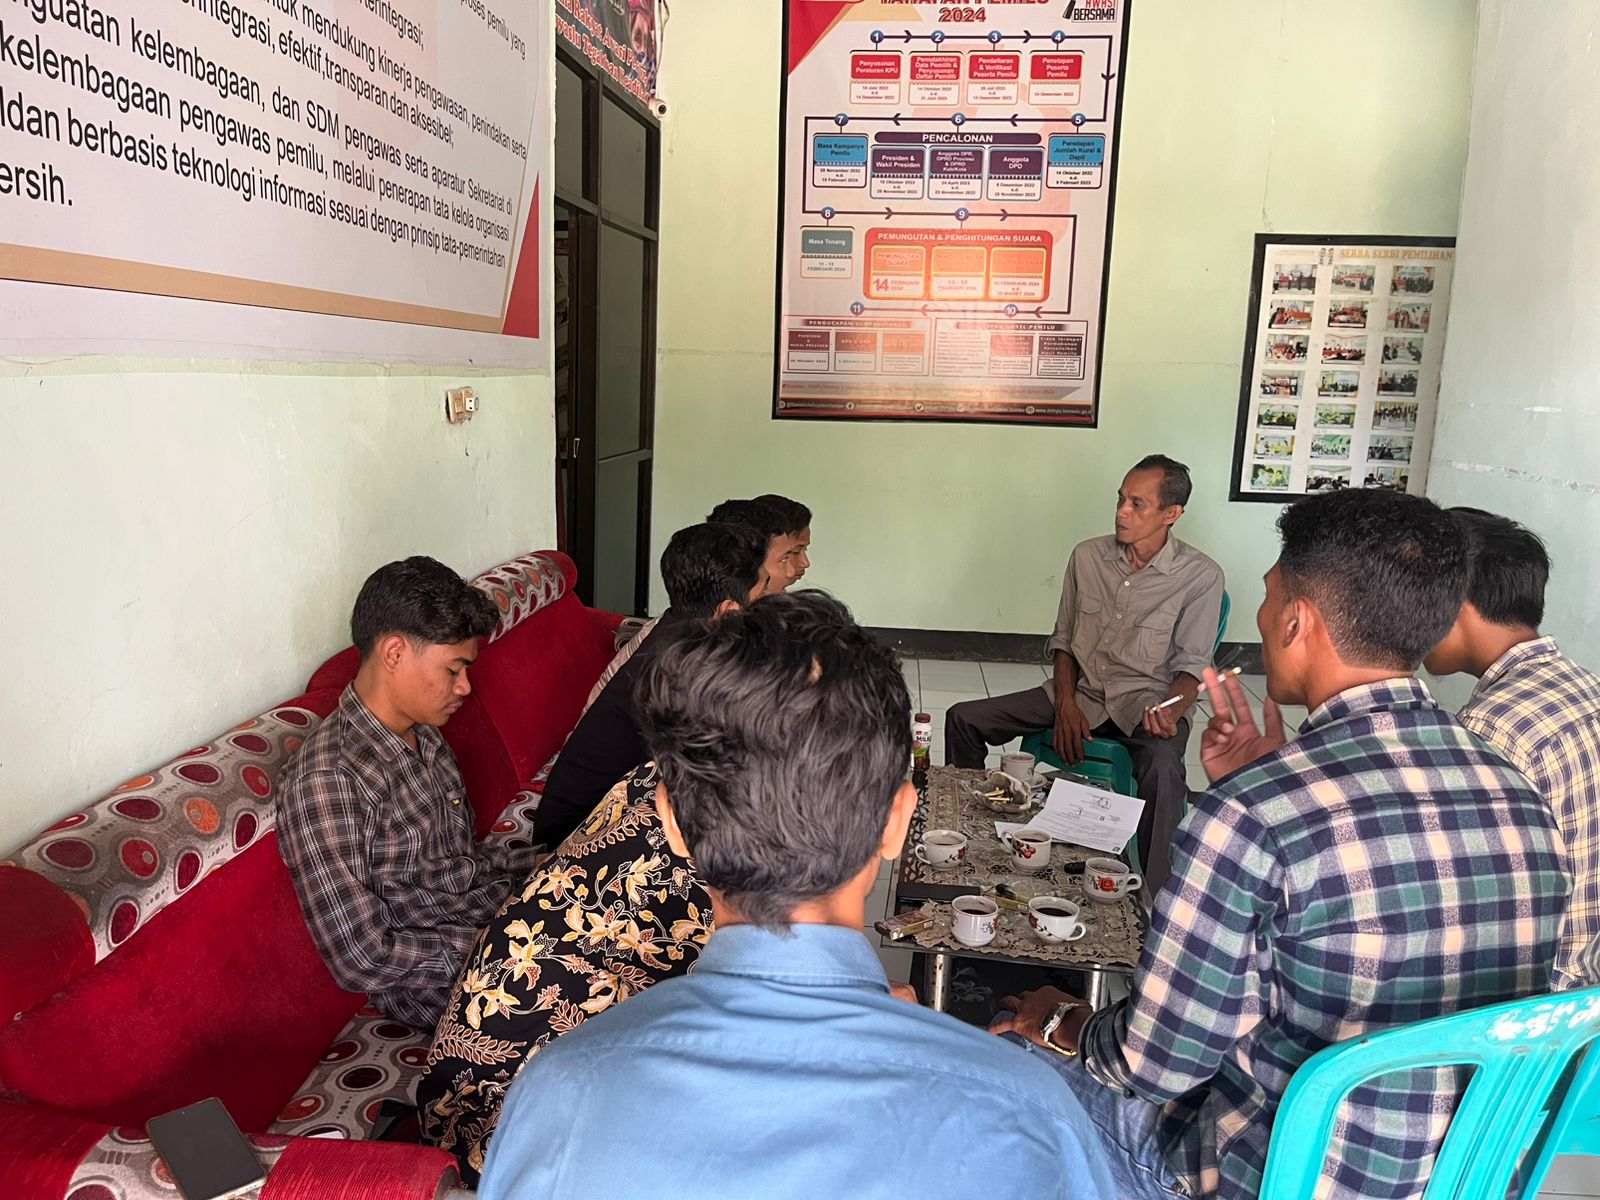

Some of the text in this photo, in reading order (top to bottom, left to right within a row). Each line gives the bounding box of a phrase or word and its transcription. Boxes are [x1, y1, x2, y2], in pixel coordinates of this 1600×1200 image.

[510, 31, 526, 60] yang
[939, 7, 986, 22] 2024
[1074, 8, 1114, 20] BERSAMA
[13, 0, 513, 216] guatan kelembagaan, dan SDM pengawas serta aparatur Sekretariat di
[182, 0, 276, 54] ntegrasi,
[390, 91, 409, 121] dan
[410, 104, 454, 148] aksesibel;
[302, 4, 376, 72] mendukung
[378, 46, 412, 91] kinerja
[415, 76, 470, 127] pengawasan,
[472, 113, 510, 150] penindakan
[511, 137, 527, 160] serta
[0, 20, 509, 242] kelembagaan pengawas pemilu, melalui penerapan tata kelola organisasi
[68, 107, 168, 171] berbasis
[172, 142, 255, 202] teknologi
[260, 169, 326, 217] informasi
[330, 199, 368, 229] sesuai
[371, 208, 409, 242] dengan
[411, 223, 440, 254] prinsip
[442, 232, 505, 268] tata-pemerintahan
[873, 278, 889, 291] 14
[1340, 249, 1453, 260] SERBA SERBI PEMILIHAN
